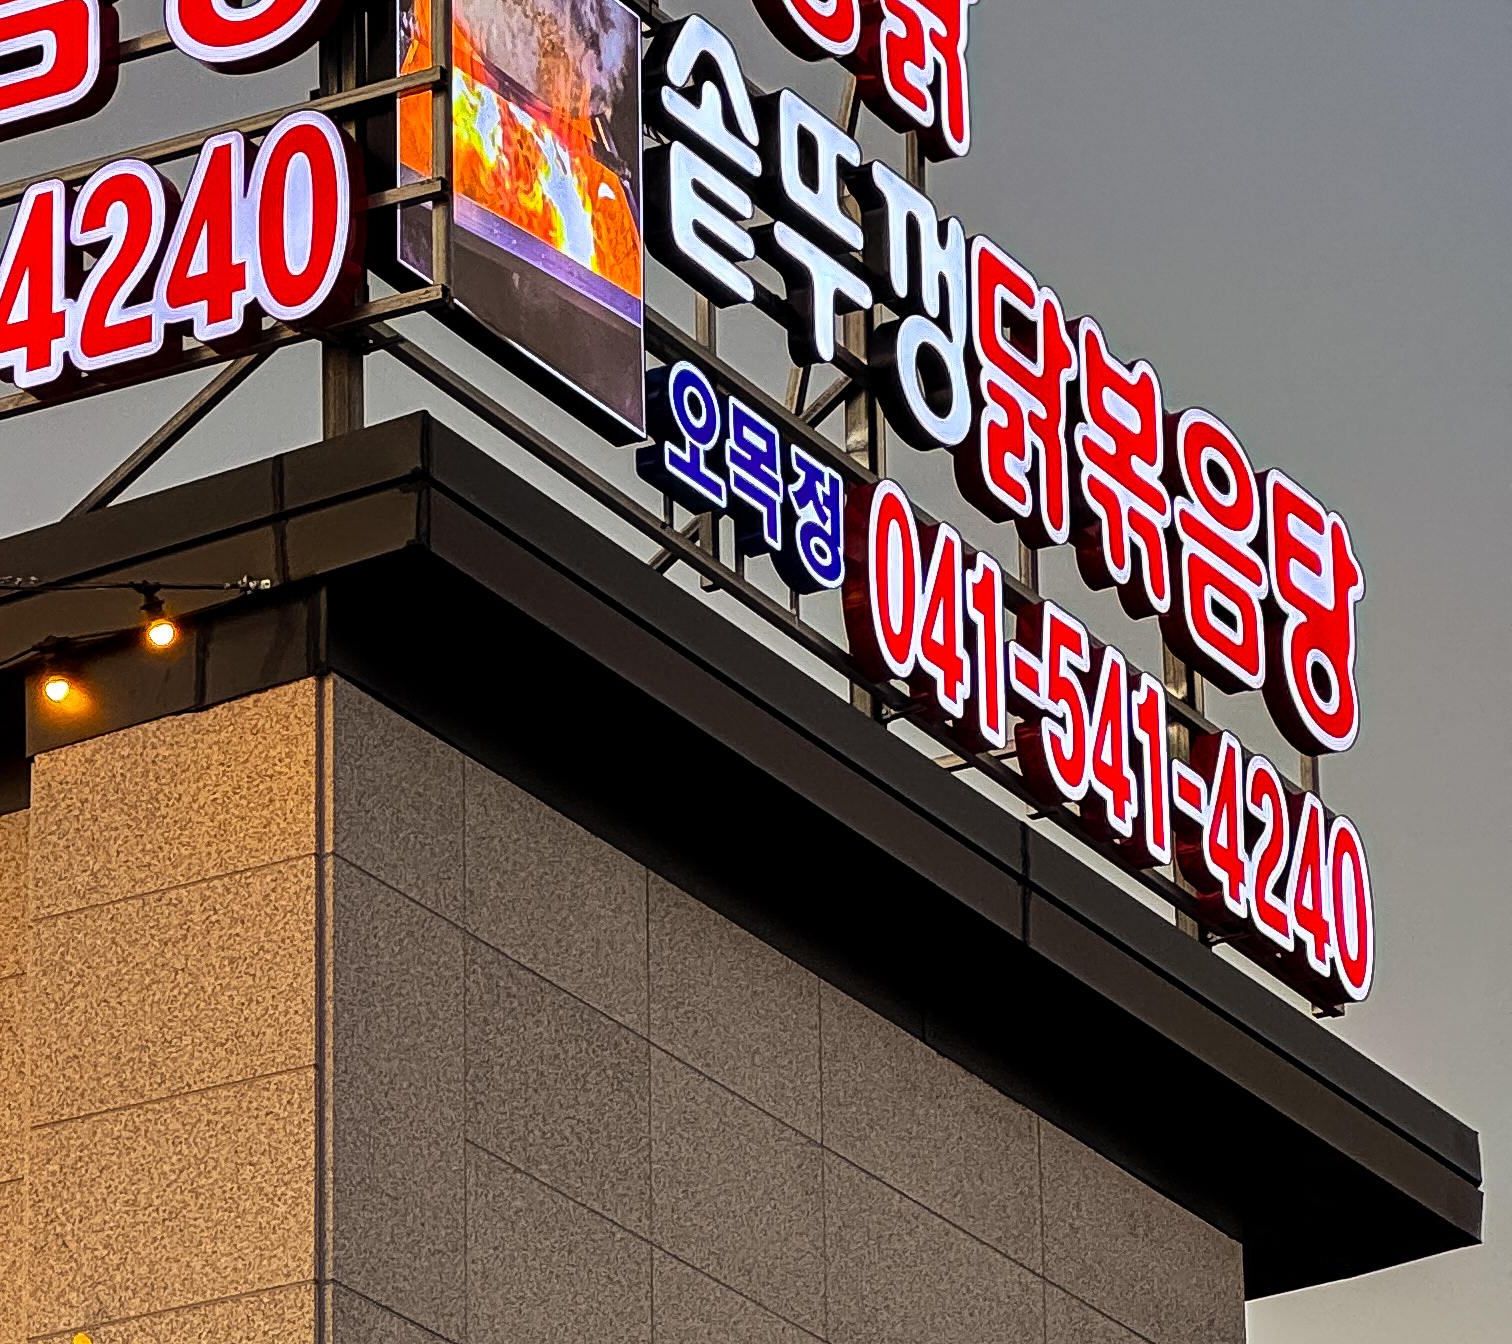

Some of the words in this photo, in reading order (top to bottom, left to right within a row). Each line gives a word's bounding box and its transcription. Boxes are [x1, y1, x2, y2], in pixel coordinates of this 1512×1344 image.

[661, 14, 972, 446] 솥뚜껑
[970, 234, 1365, 752] 닭볶음탕
[665, 361, 846, 589] 오목정
[868, 478, 1375, 1003] 041-541-4240
